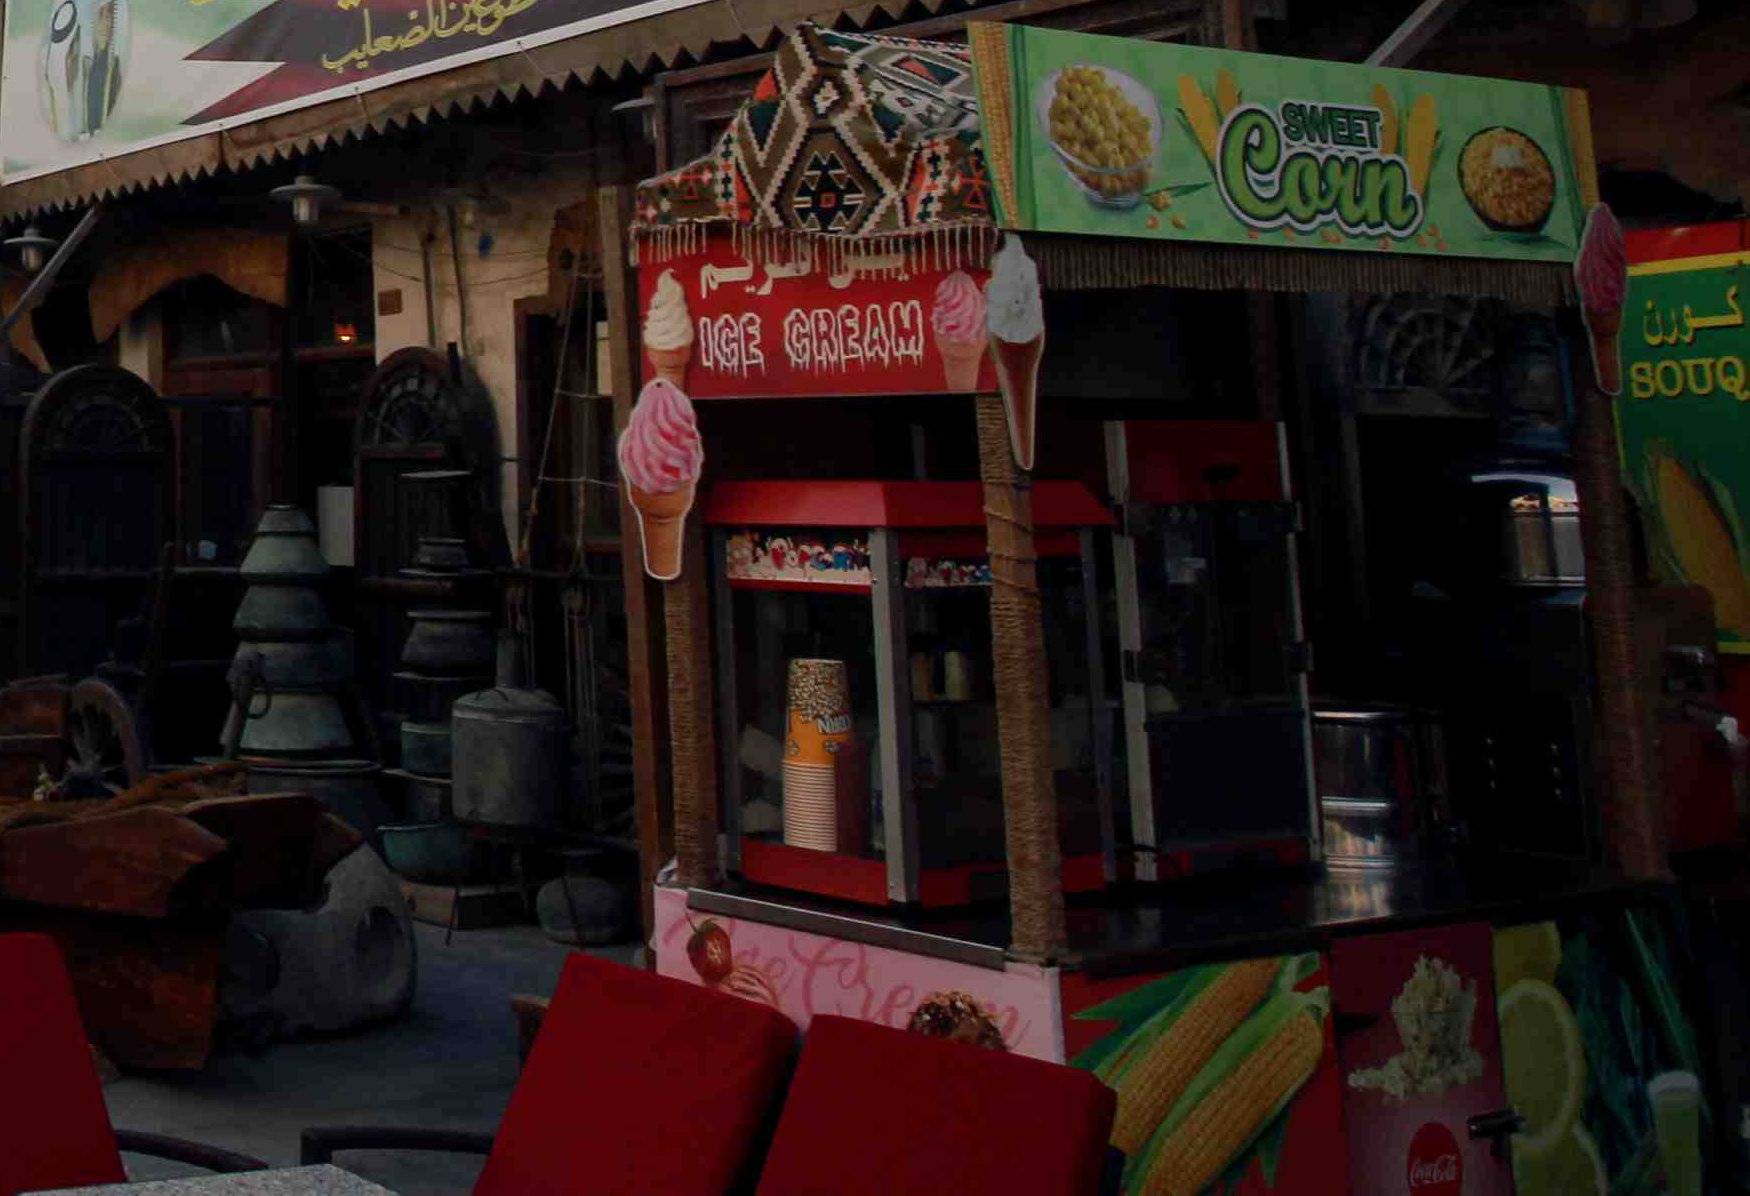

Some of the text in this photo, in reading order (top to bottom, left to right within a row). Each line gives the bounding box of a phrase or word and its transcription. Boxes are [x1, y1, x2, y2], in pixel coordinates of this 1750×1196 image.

[1280, 101, 1383, 149] SWEET
[1217, 104, 1421, 234] Corn
[698, 298, 925, 380] ICE CREAM
[1628, 355, 1750, 404] SOUQ
